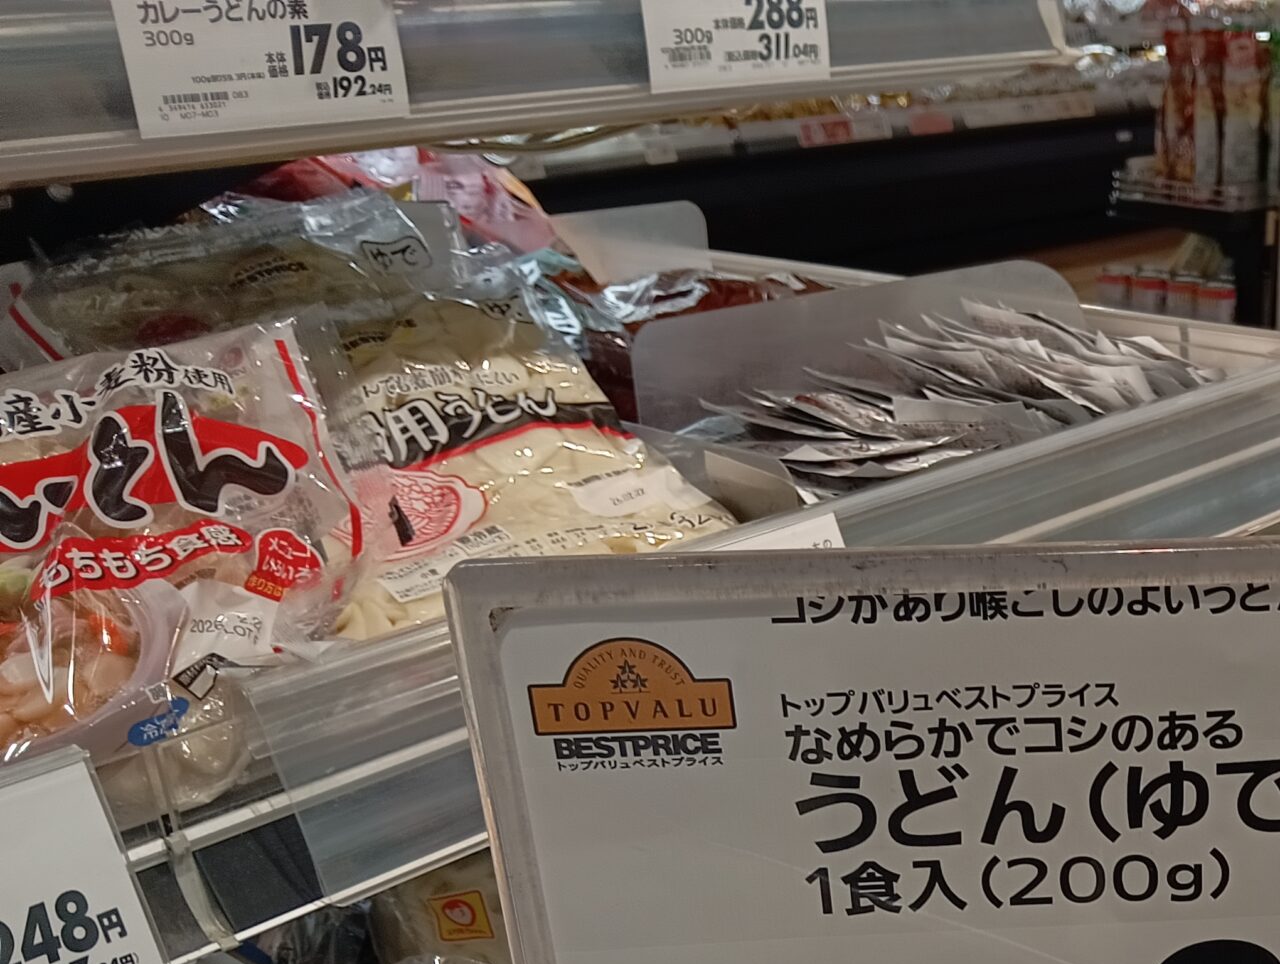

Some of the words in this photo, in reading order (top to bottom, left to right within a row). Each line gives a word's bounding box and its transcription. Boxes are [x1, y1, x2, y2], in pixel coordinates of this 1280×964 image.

[143, 30, 195, 48] 300g
[289, 21, 388, 77] 178円
[672, 27, 714, 46] 300g
[574, 648, 615, 690] QUALITY
[619, 646, 648, 662] AND
[650, 654, 686, 688] TRUST
[547, 697, 720, 723] TOPVALU
[779, 683, 1120, 718] トップバリュベストプライス
[553, 732, 724, 761] BESTPRICE
[784, 708, 1244, 765] なめらかでコシのある
[556, 754, 725, 772] トップバリュベストプライス
[803, 847, 1232, 918] 1食入(200g)
